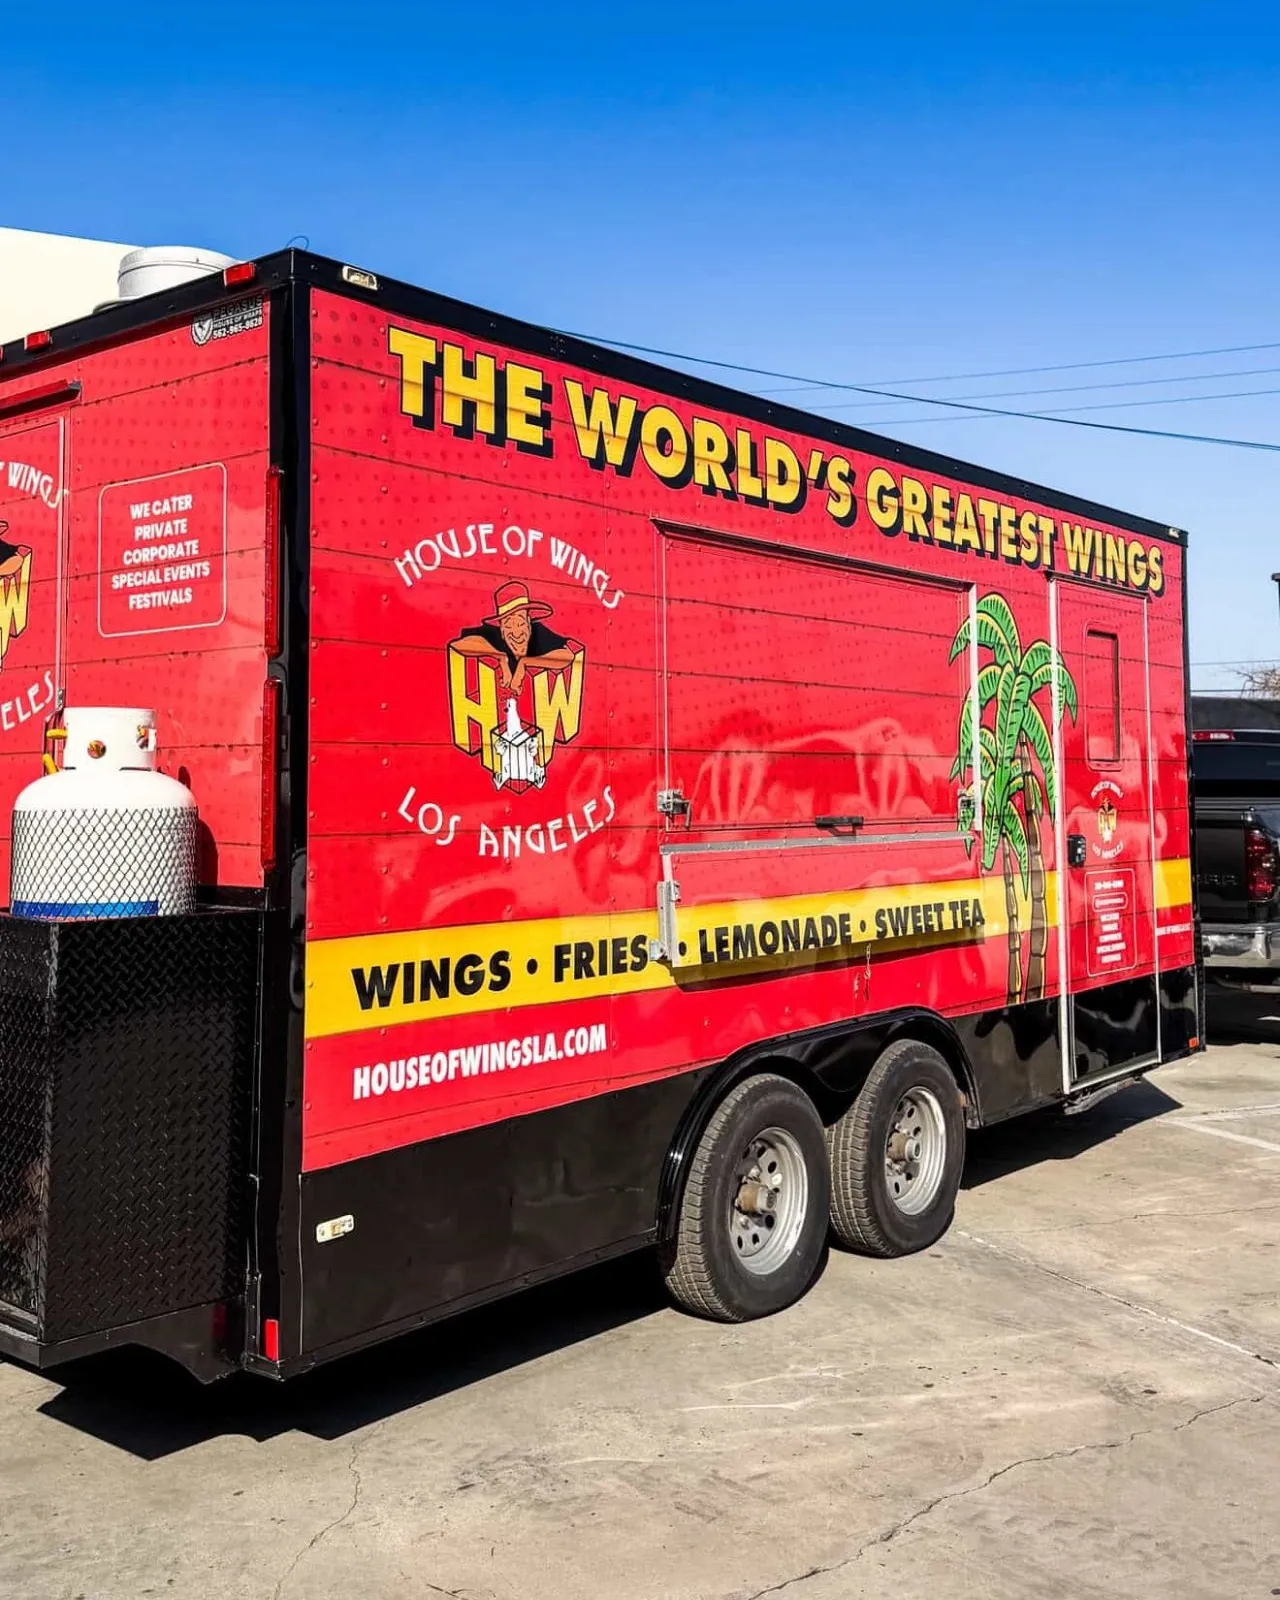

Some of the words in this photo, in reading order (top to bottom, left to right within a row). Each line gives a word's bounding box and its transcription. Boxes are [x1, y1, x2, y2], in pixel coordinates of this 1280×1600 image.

[8, 461, 70, 509] WINGS
[388, 325, 553, 458] THE
[564, 378, 857, 527] WORLD'S
[866, 467, 1056, 570] GREATEST
[1062, 521, 1164, 597] WINGS
[130, 500, 152, 520] WE
[152, 494, 193, 517] CATER
[134, 518, 188, 541] PRIVATE
[111, 566, 163, 590] SPECIAL
[163, 561, 211, 583] EVENTS
[123, 539, 199, 567] CORPORATE
[394, 523, 497, 587] HOUSE
[503, 525, 543, 558] OF
[550, 536, 625, 609] WINGS
[128, 587, 193, 611] FESTIVALS
[398, 786, 461, 845] LOS
[478, 785, 615, 858] ANGELES
[351, 950, 512, 1011] WINGS
[554, 934, 648, 983] FRIES
[699, 913, 851, 964] LEMONADE
[874, 901, 945, 939] SWEET
[950, 898, 986, 928] TEA
[352, 1023, 607, 1100] HOUSEOFWINGSLA.COM
